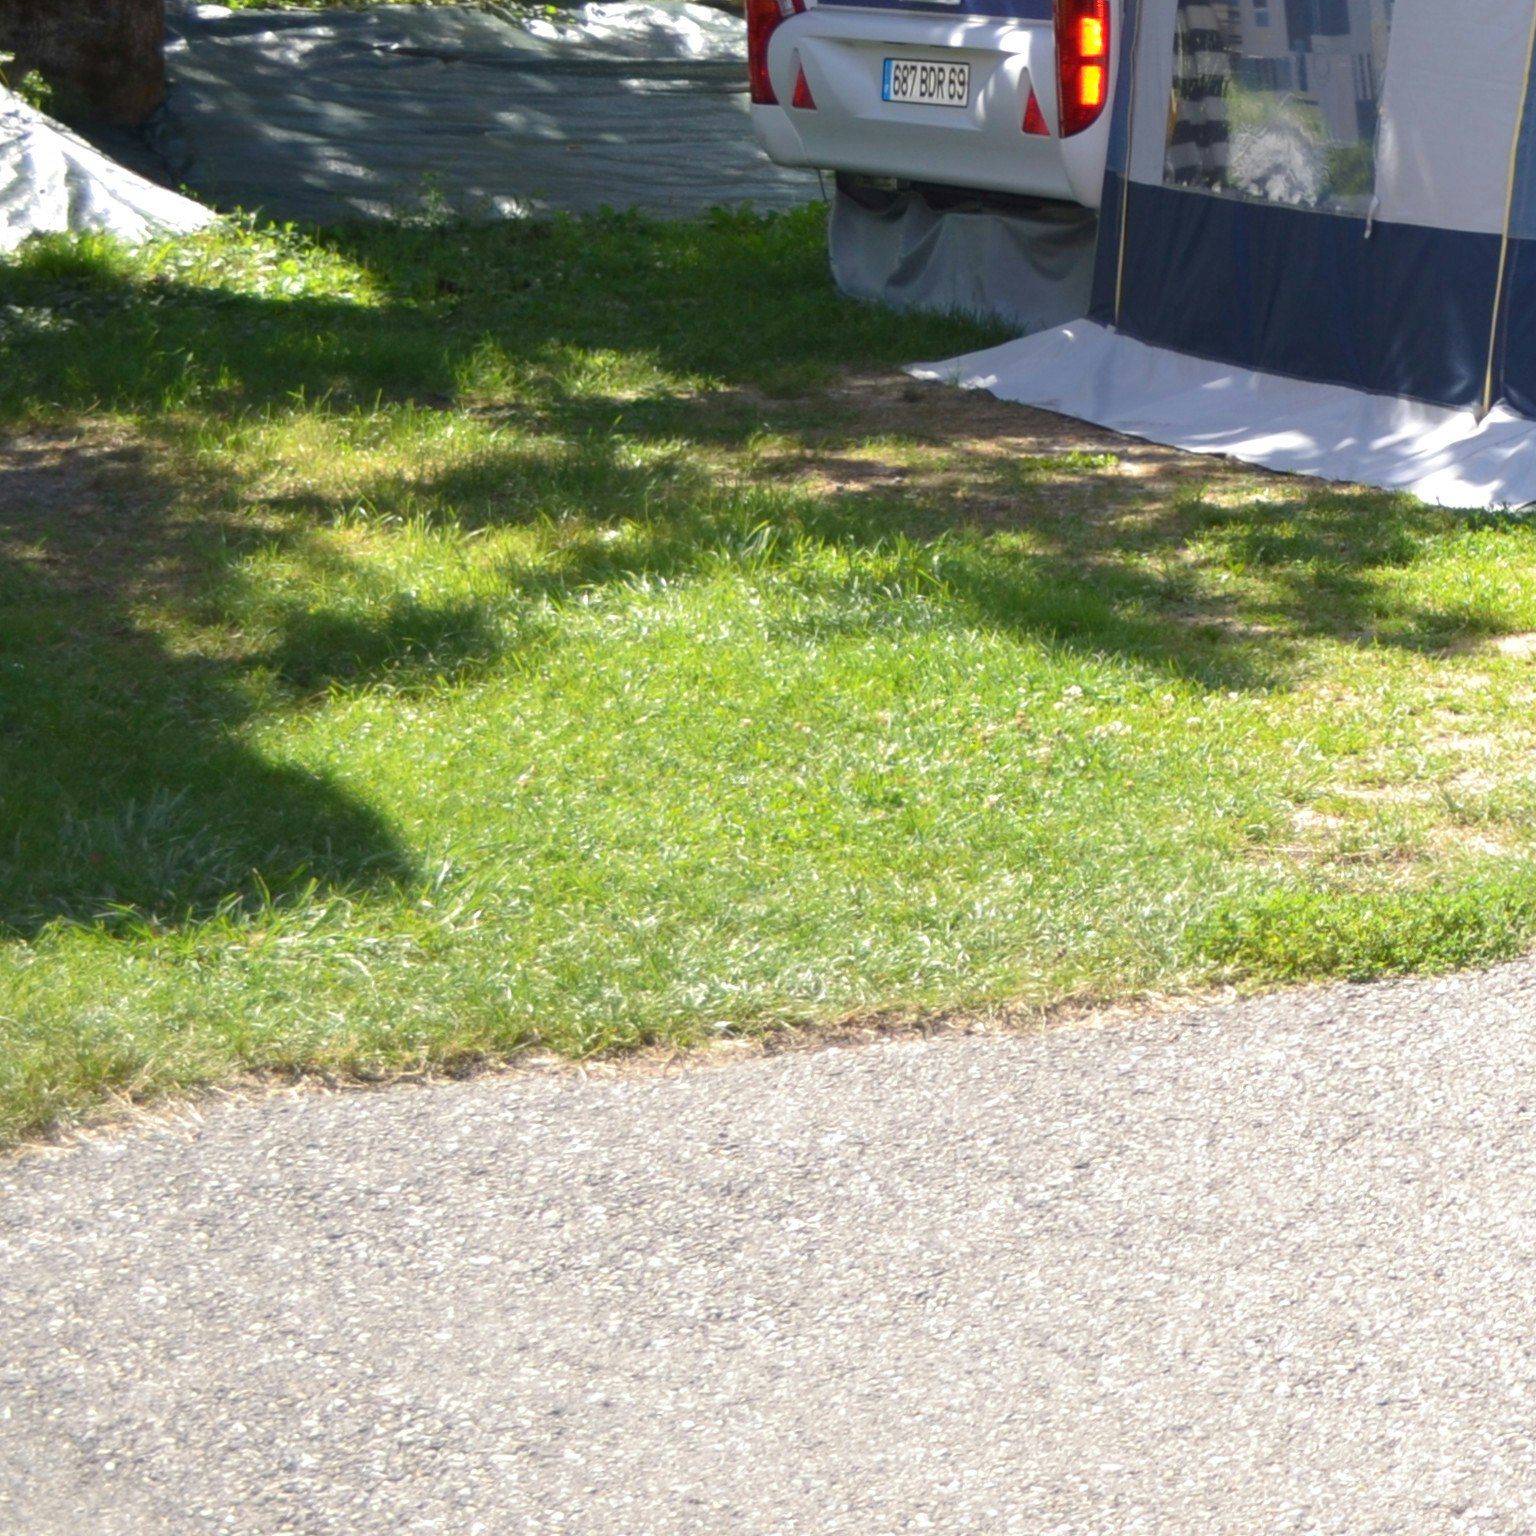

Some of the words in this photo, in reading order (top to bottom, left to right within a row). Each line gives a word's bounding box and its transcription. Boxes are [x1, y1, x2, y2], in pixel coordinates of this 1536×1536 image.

[893, 64, 917, 97] 687
[920, 66, 945, 99] BDR
[948, 67, 966, 101] 69
